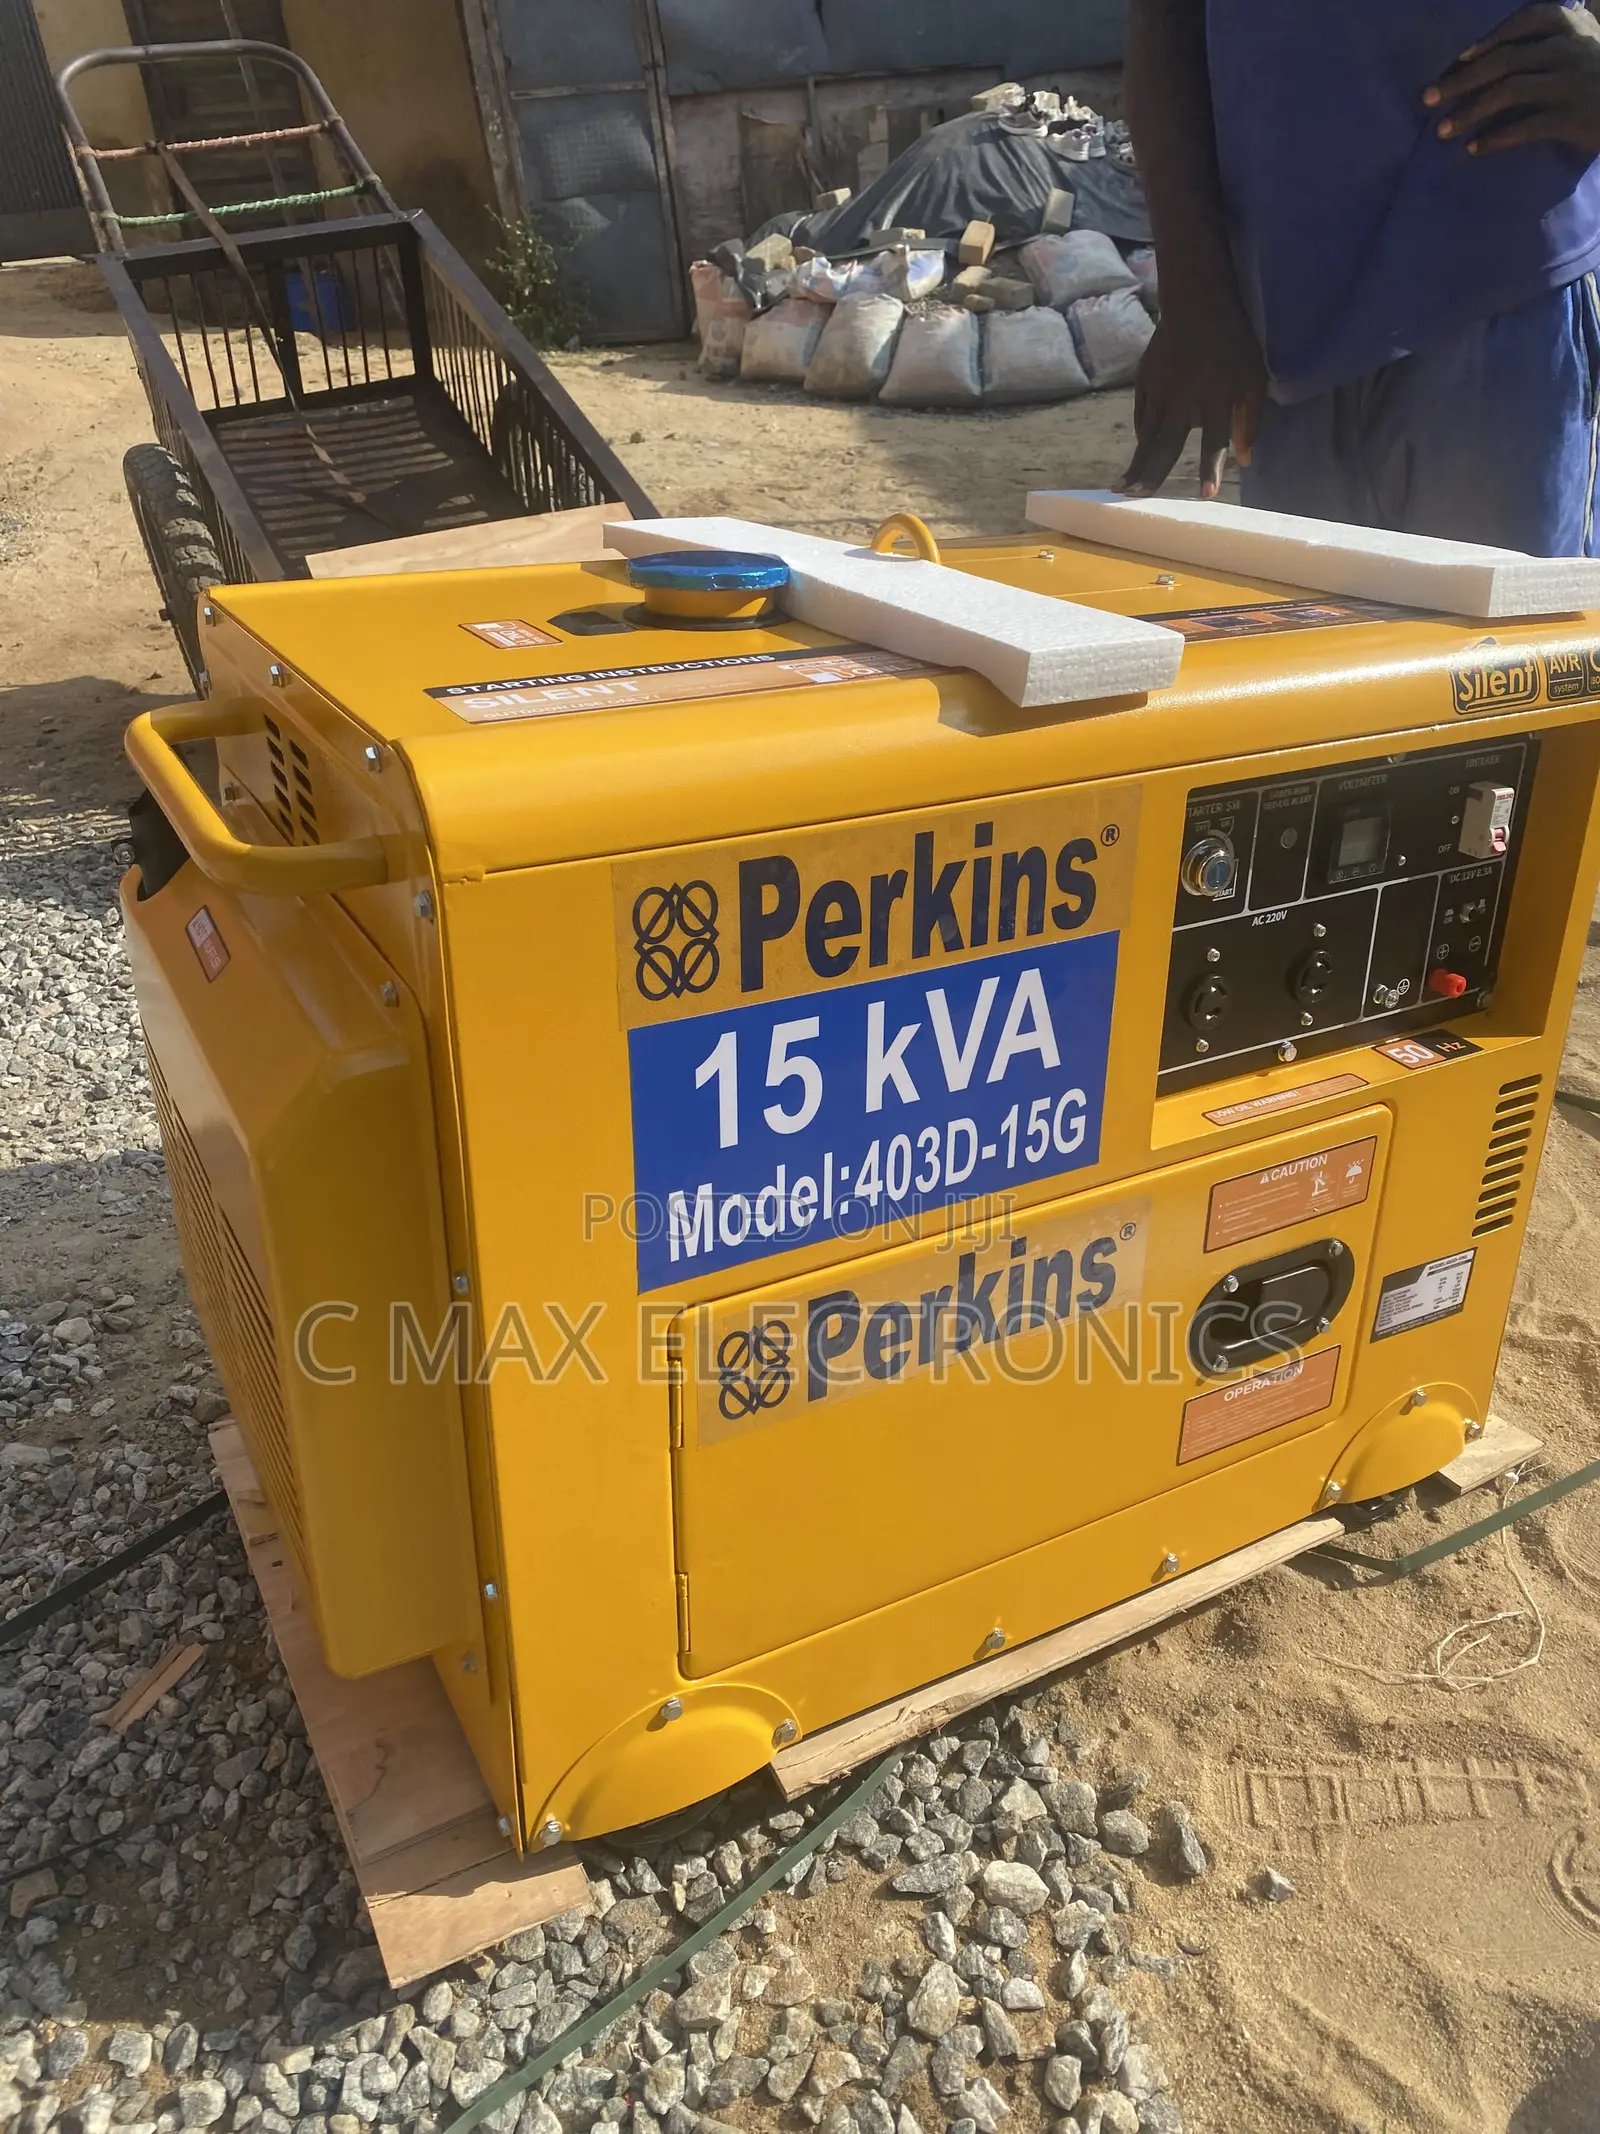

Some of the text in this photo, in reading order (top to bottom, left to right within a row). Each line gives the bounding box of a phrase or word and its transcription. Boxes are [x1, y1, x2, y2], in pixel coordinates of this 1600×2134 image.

[447, 674, 582, 695] STARTING
[588, 655, 776, 680] INSTRUCTIONS
[1459, 652, 1534, 701] Silent
[1550, 653, 1582, 674] AVR
[463, 680, 639, 709] SILENT
[1553, 682, 1579, 695] system
[1251, 910, 1288, 927] AC 220V
[695, 968, 1061, 1149] 15 kVA
[1386, 1041, 1467, 1064] 50 Hz
[1211, 1108, 1236, 1119] LOW
[1235, 1103, 1252, 1112] OIL
[1270, 1153, 1329, 1182] CAUTION
[1223, 1365, 1304, 1402] OPERATION
